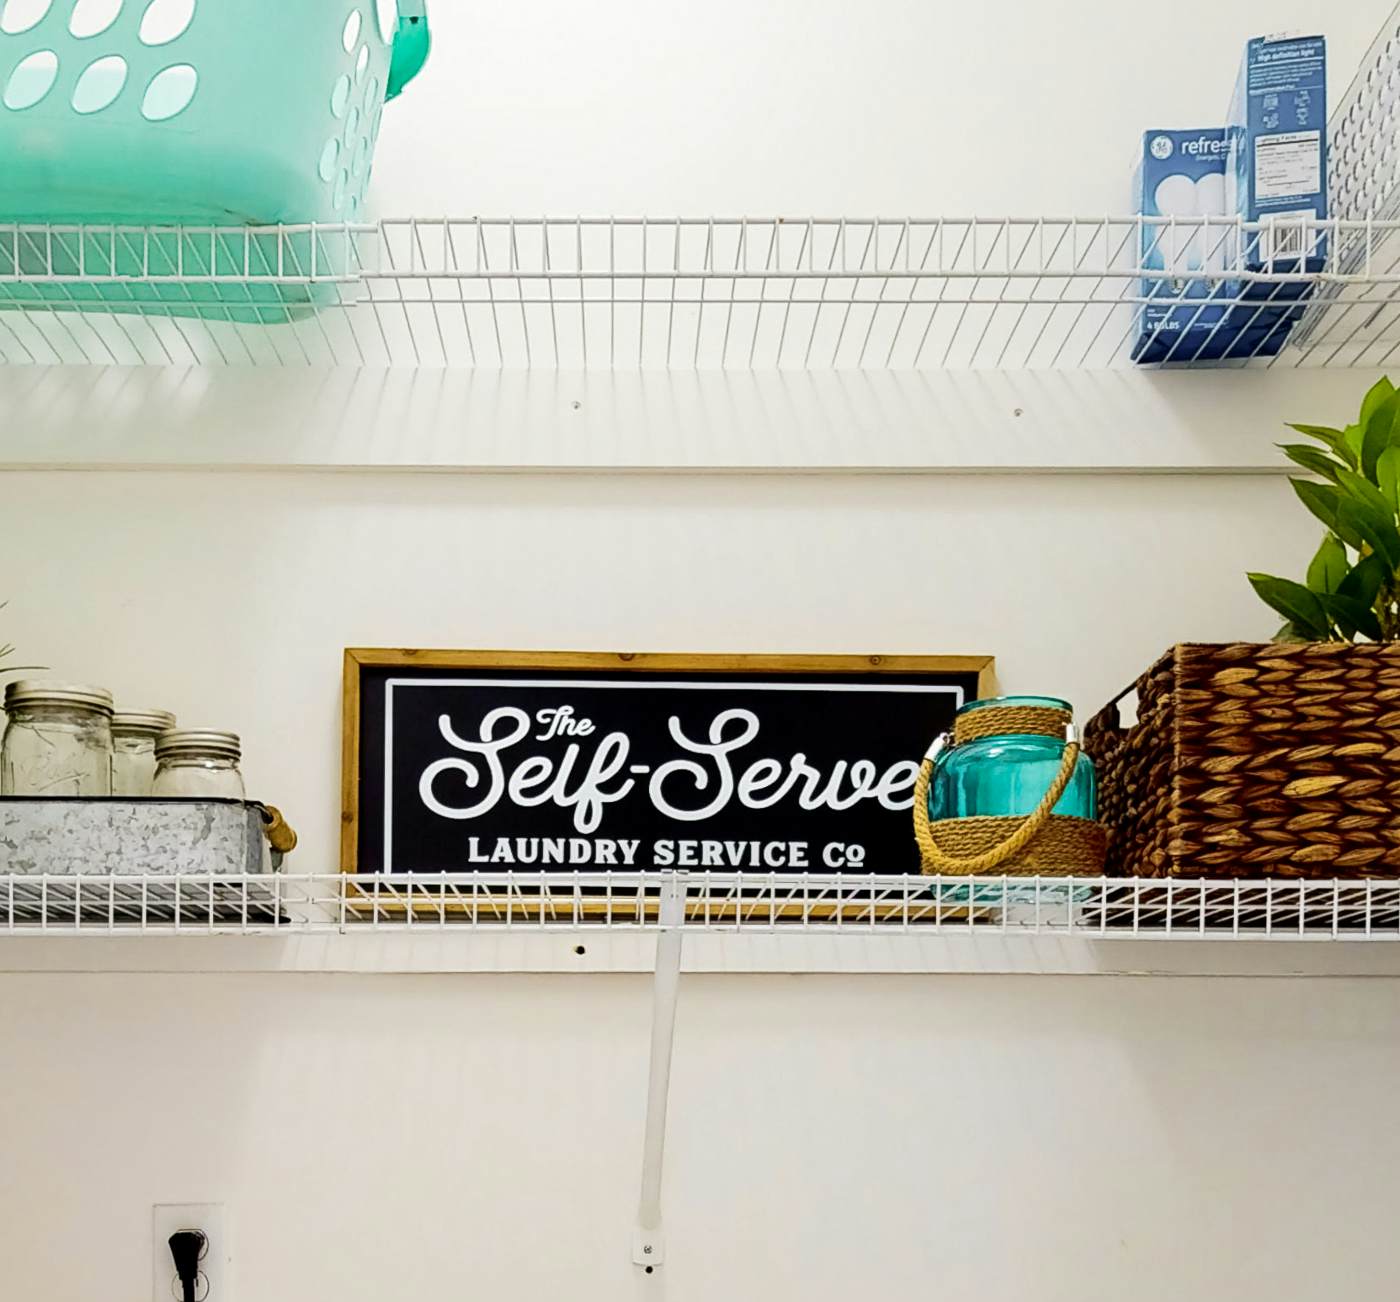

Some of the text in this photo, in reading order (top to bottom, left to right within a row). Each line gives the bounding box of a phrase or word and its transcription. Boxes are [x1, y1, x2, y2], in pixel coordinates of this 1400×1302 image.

[535, 704, 596, 742] The
[418, 706, 919, 834] Self-Serve
[467, 836, 639, 866] LAUNDRY
[653, 840, 809, 868] SERVICE
